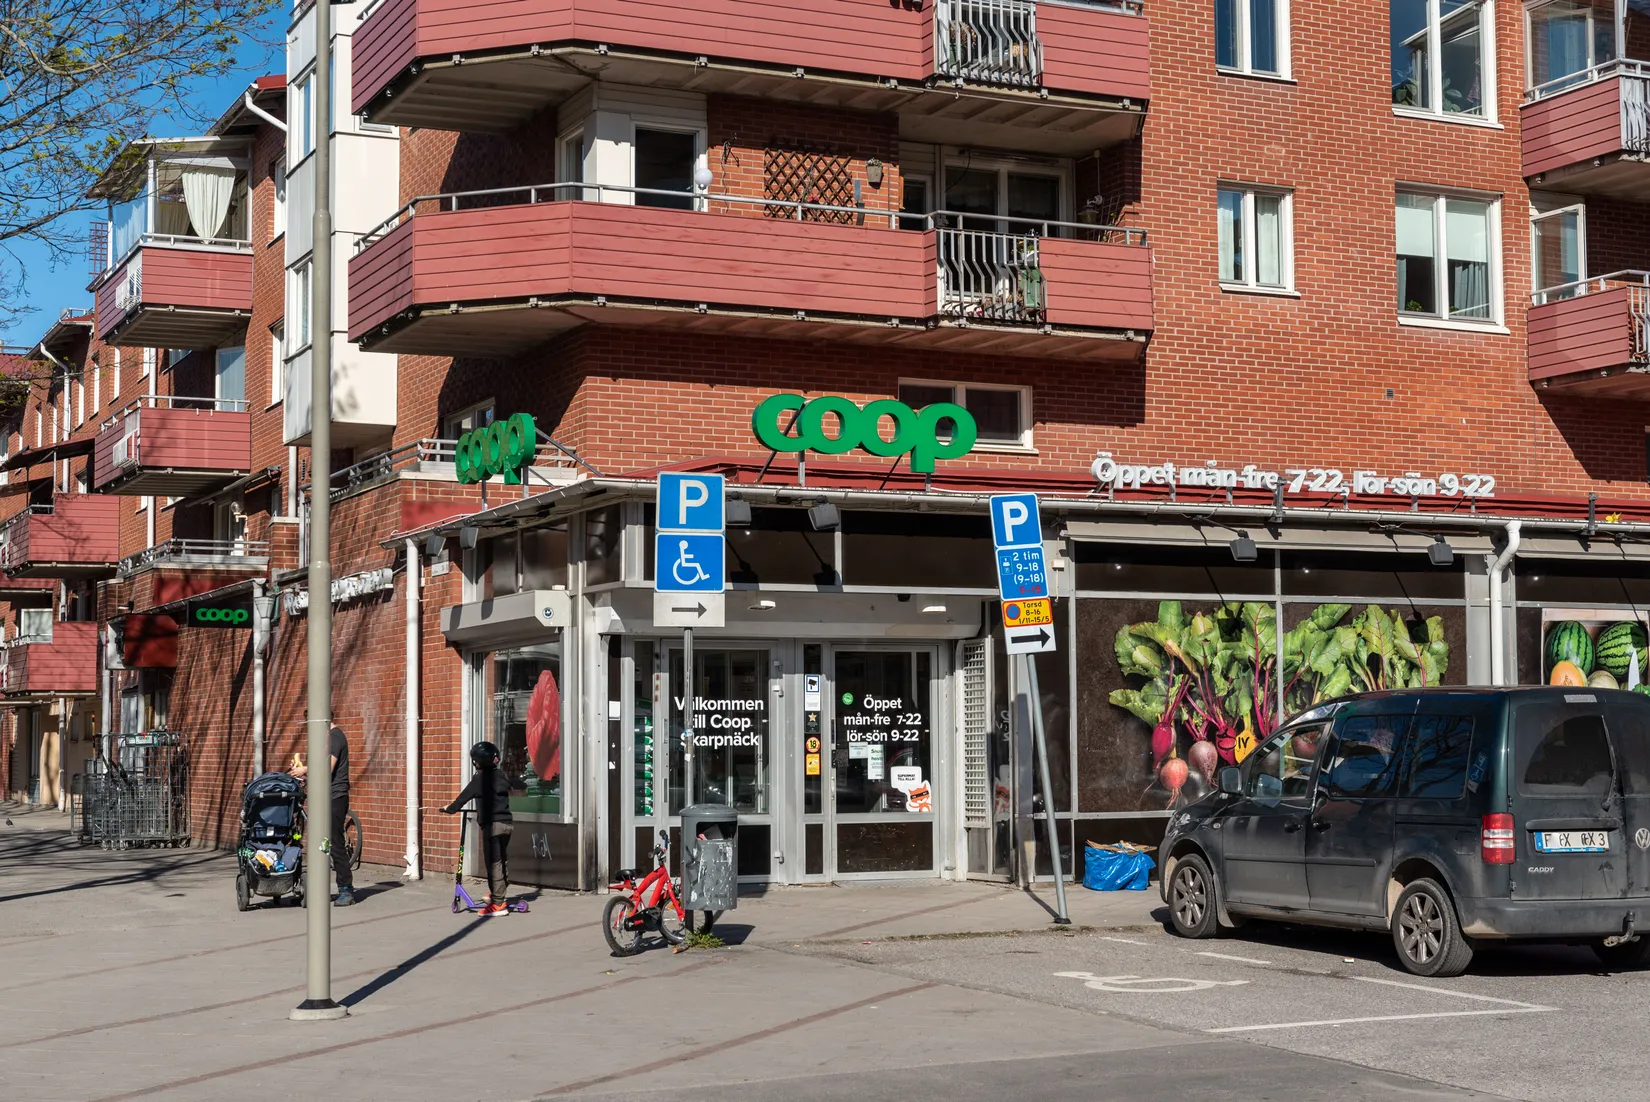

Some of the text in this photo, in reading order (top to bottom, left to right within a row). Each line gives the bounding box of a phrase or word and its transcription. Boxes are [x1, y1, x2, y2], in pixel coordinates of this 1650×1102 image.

[752, 393, 977, 473] coop
[455, 412, 536, 485] coop
[1091, 451, 1176, 489] Öppet
[679, 480, 709, 525] P
[1002, 501, 1028, 542] P
[1012, 551, 1040, 561] 2 tim
[1016, 562, 1039, 572] 9-18
[1013, 572, 1044, 584] (9-18)
[196, 608, 248, 624] coop
[674, 696, 764, 711] Vlkommen
[863, 694, 903, 712] Öppet
[692, 714, 751, 732] ill Coop
[843, 712, 922, 725] mån-fre 7-22
[846, 729, 920, 741] lör-sön 9-22
